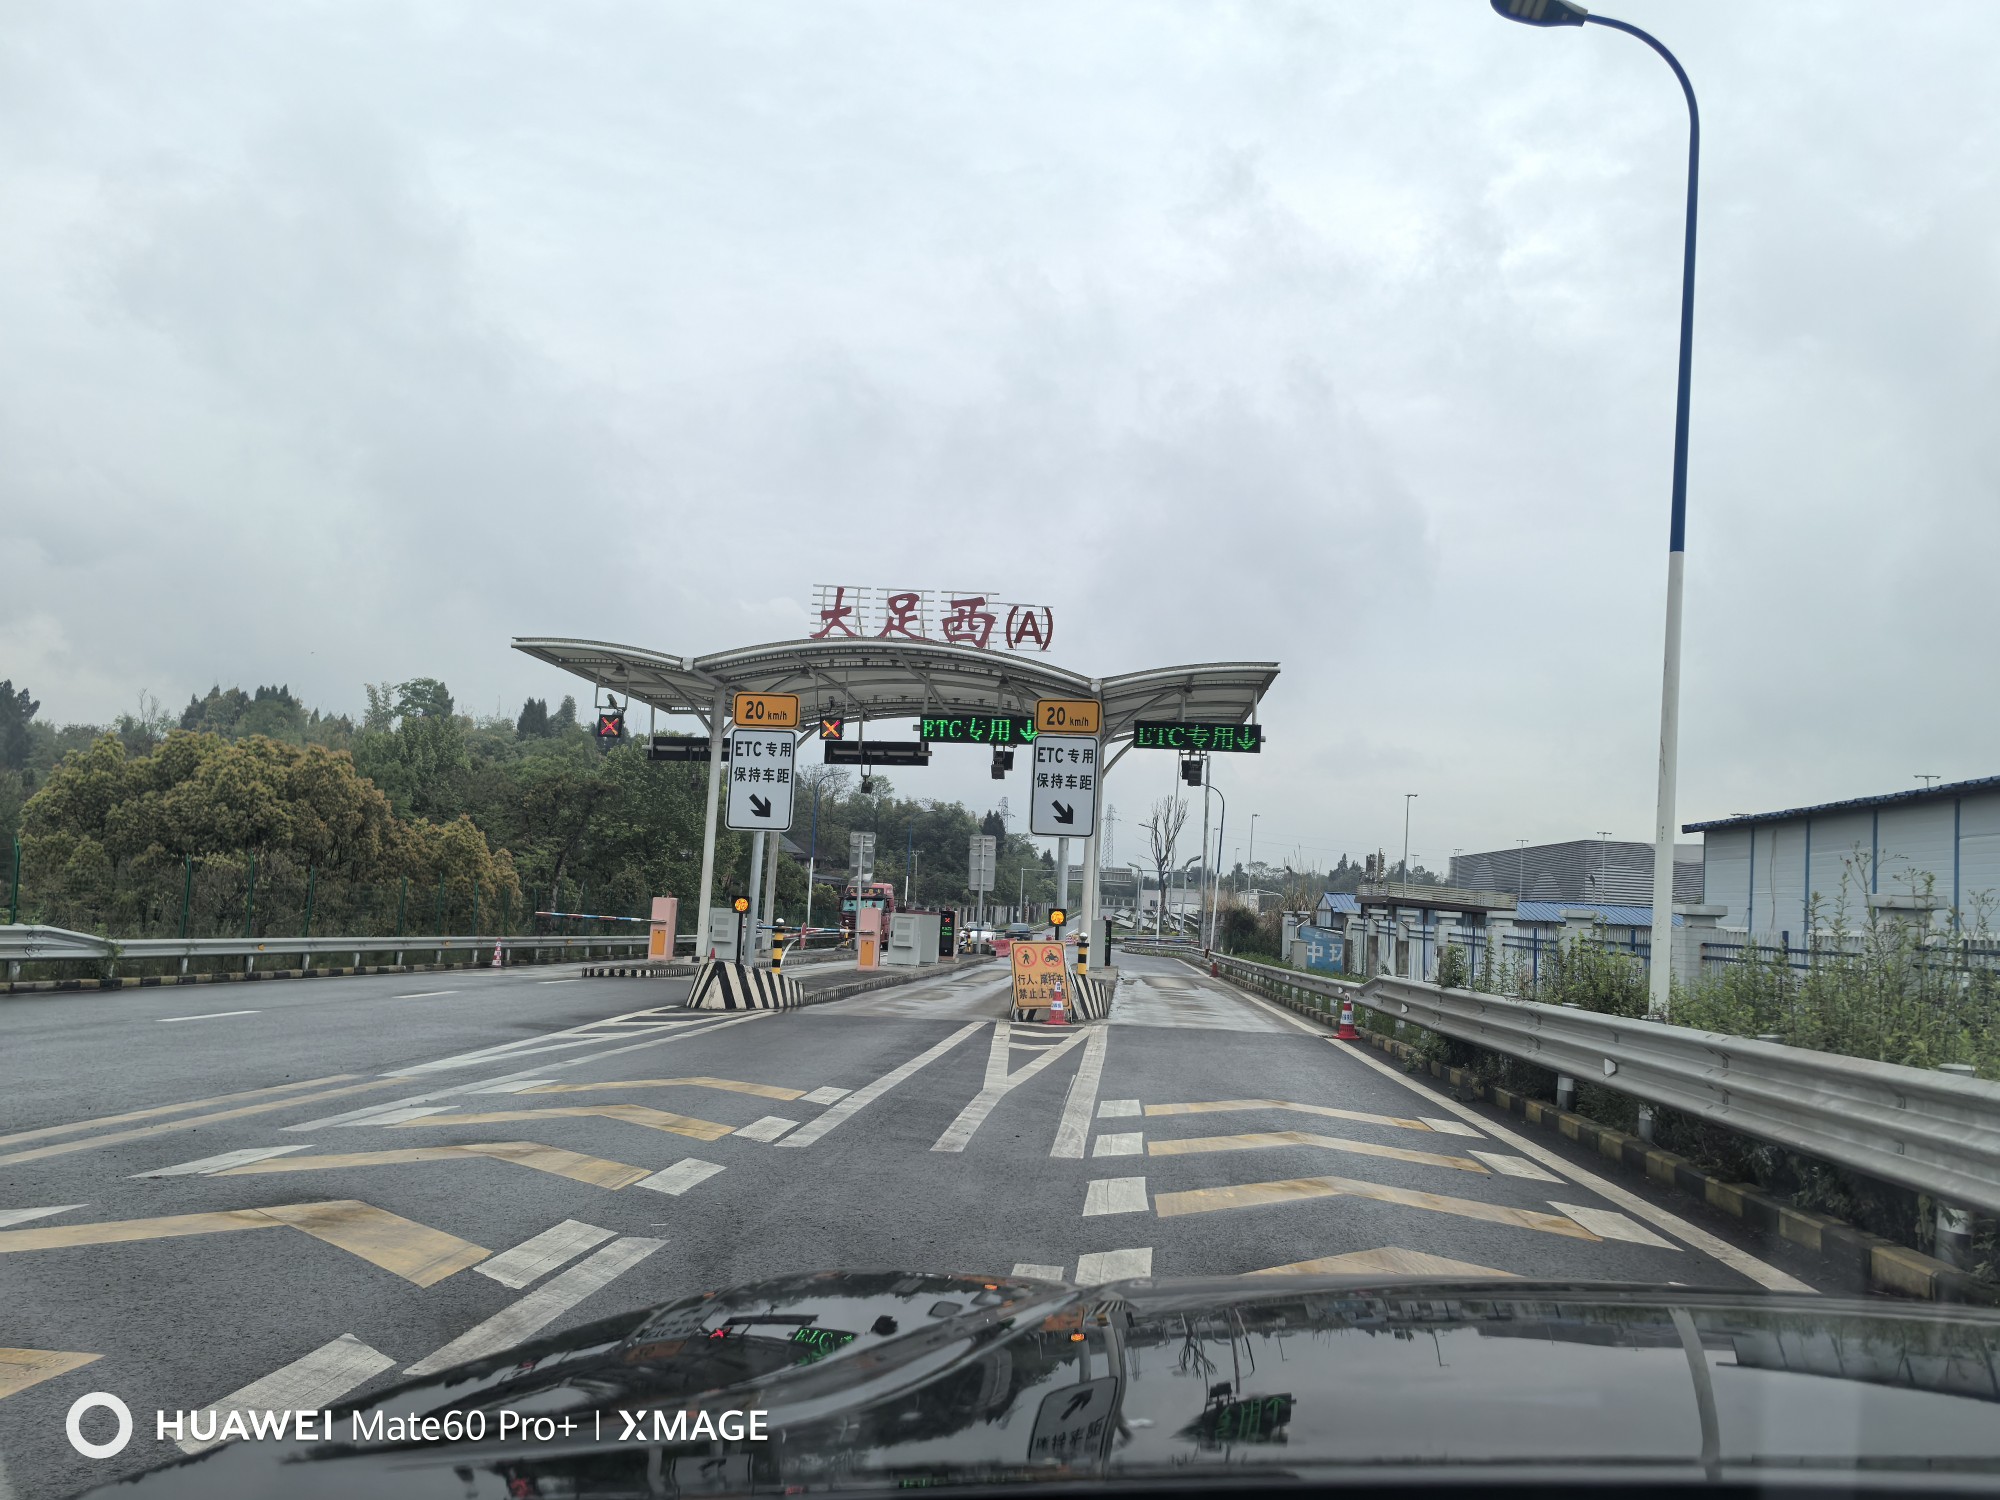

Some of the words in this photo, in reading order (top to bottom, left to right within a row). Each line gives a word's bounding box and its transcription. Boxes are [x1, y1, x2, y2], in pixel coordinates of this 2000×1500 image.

[745, 700, 765, 720] 20
[767, 711, 788, 721] km/h
[1046, 706, 1066, 726] 20
[1069, 717, 1089, 727] km/h
[733, 766, 790, 784] 保持车距
[1036, 772, 1093, 790] 保持车距
